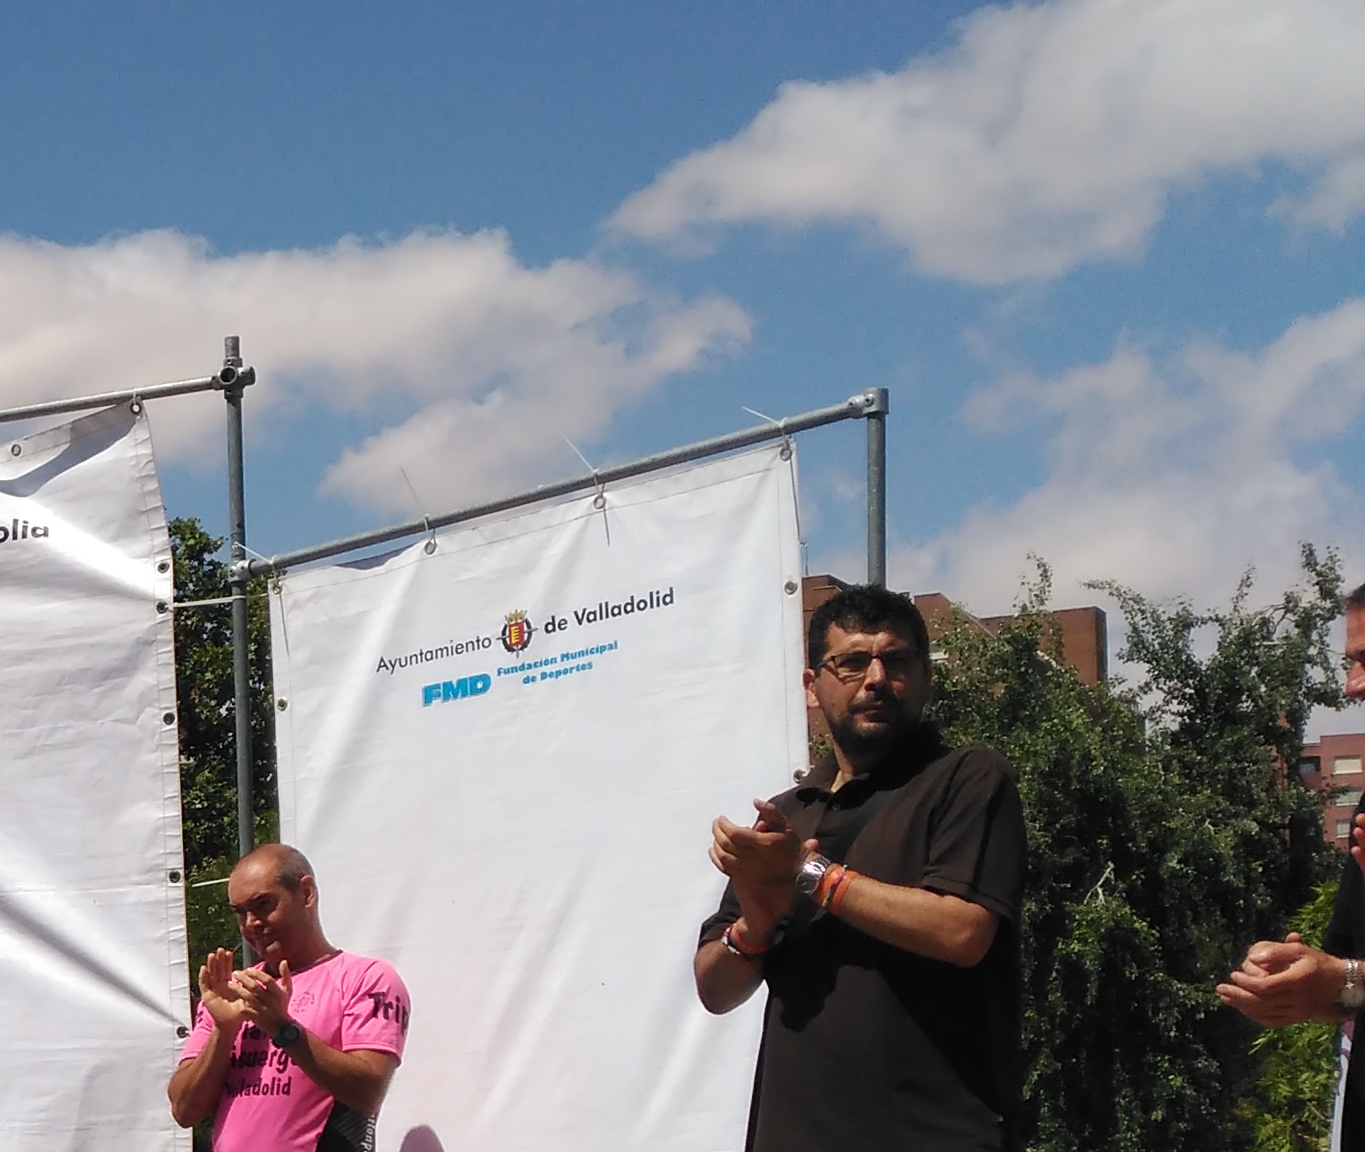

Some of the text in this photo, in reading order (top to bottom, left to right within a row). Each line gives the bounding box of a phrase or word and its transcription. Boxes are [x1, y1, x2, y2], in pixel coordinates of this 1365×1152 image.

[376, 587, 674, 674] Ayuntamiento de Valladolid
[497, 641, 618, 677] Fundación Municipal
[523, 661, 593, 684] de Deportes
[422, 673, 491, 707] FMD
